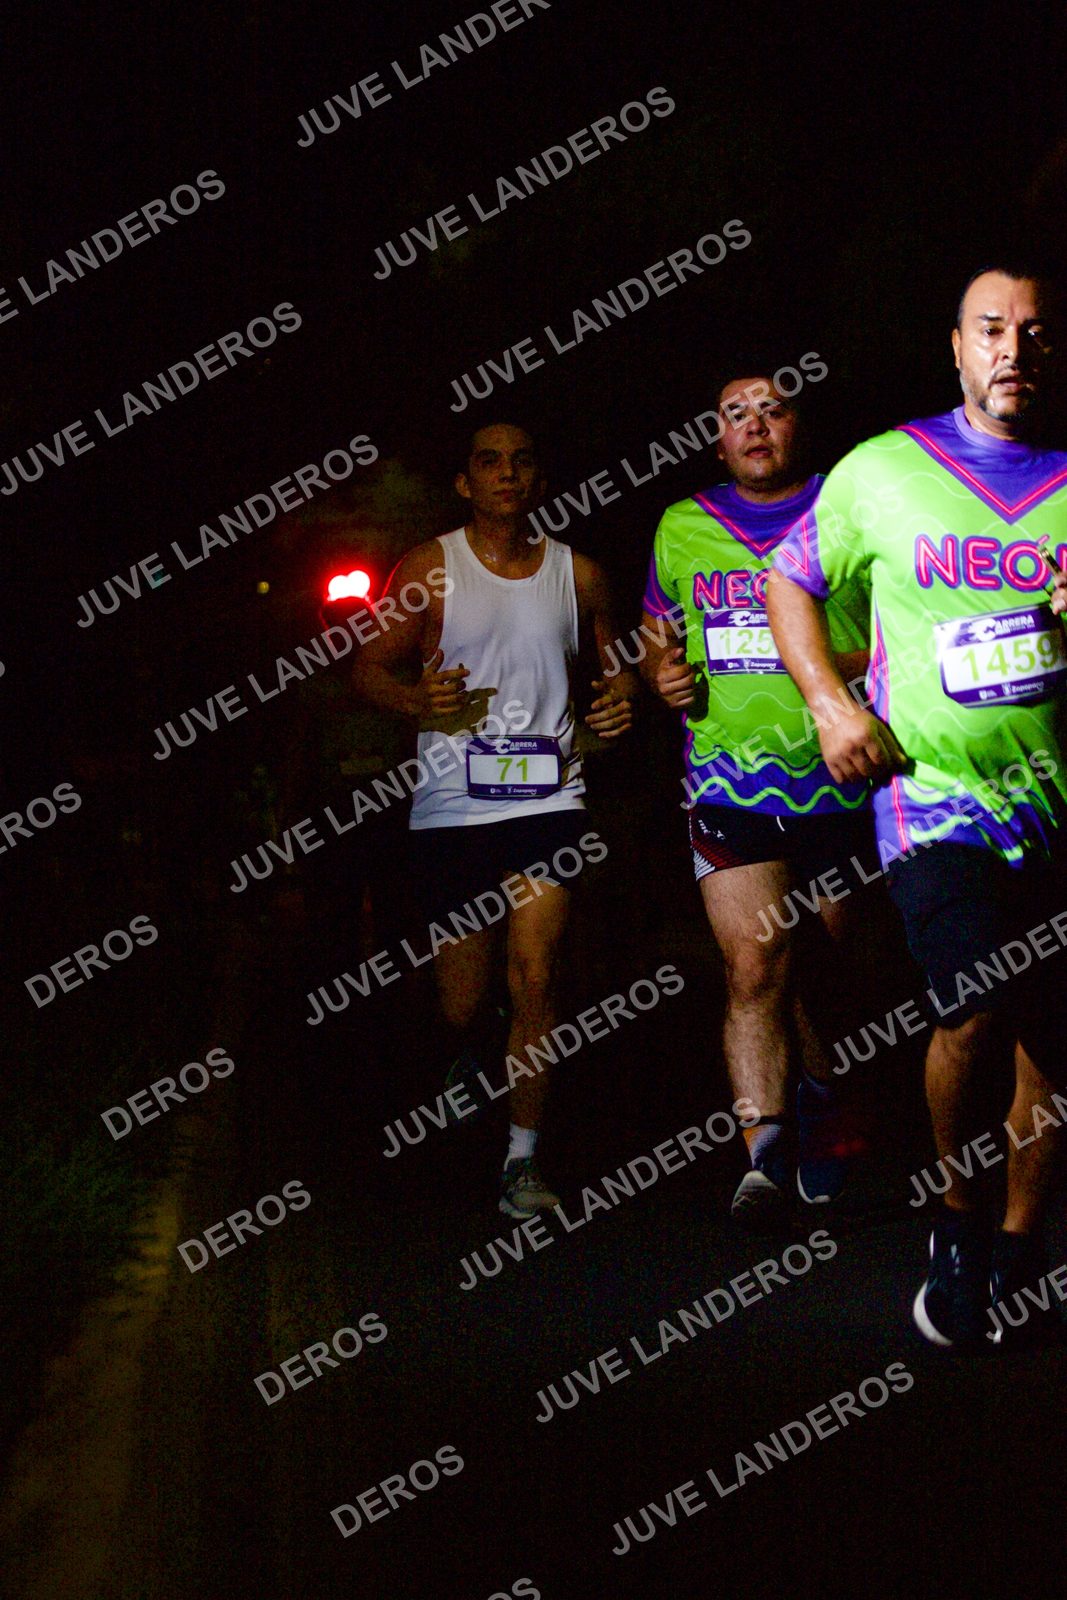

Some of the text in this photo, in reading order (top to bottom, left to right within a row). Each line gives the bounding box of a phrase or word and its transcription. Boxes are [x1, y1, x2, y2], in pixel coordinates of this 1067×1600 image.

[915, 534, 1067, 592] NEÓ
[962, 632, 1058, 683] 1459
[497, 757, 528, 782] 71
